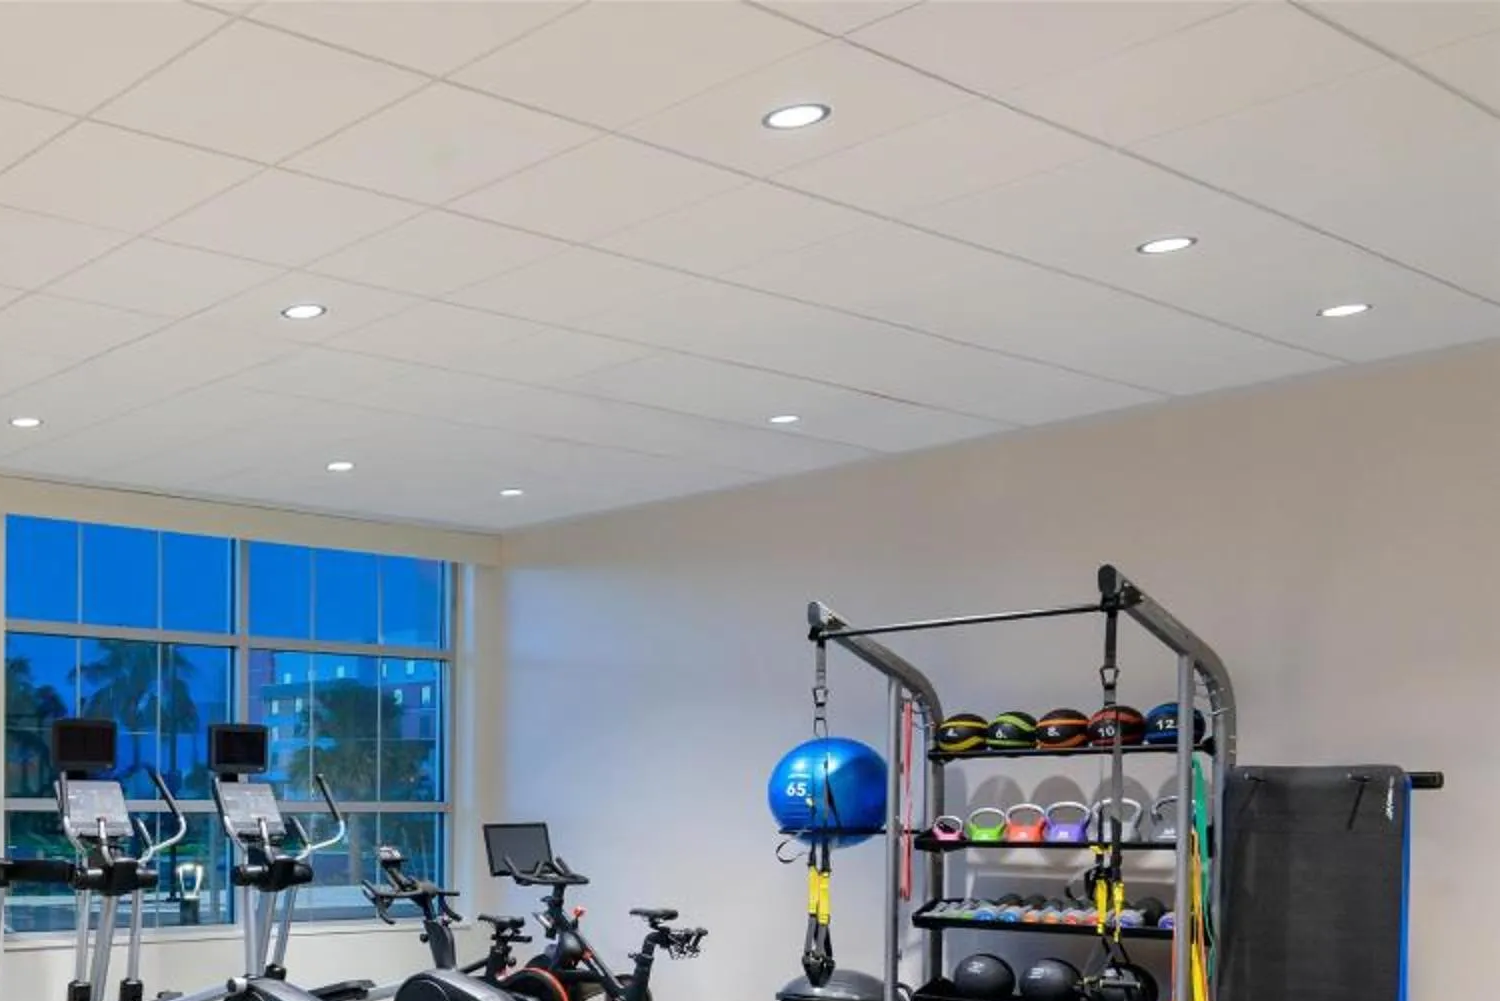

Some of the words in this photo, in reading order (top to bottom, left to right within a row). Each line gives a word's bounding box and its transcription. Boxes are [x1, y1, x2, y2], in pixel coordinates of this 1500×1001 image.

[1098, 725, 1115, 737] 10
[1156, 719, 1176, 731] 12
[786, 781, 807, 797] 65
